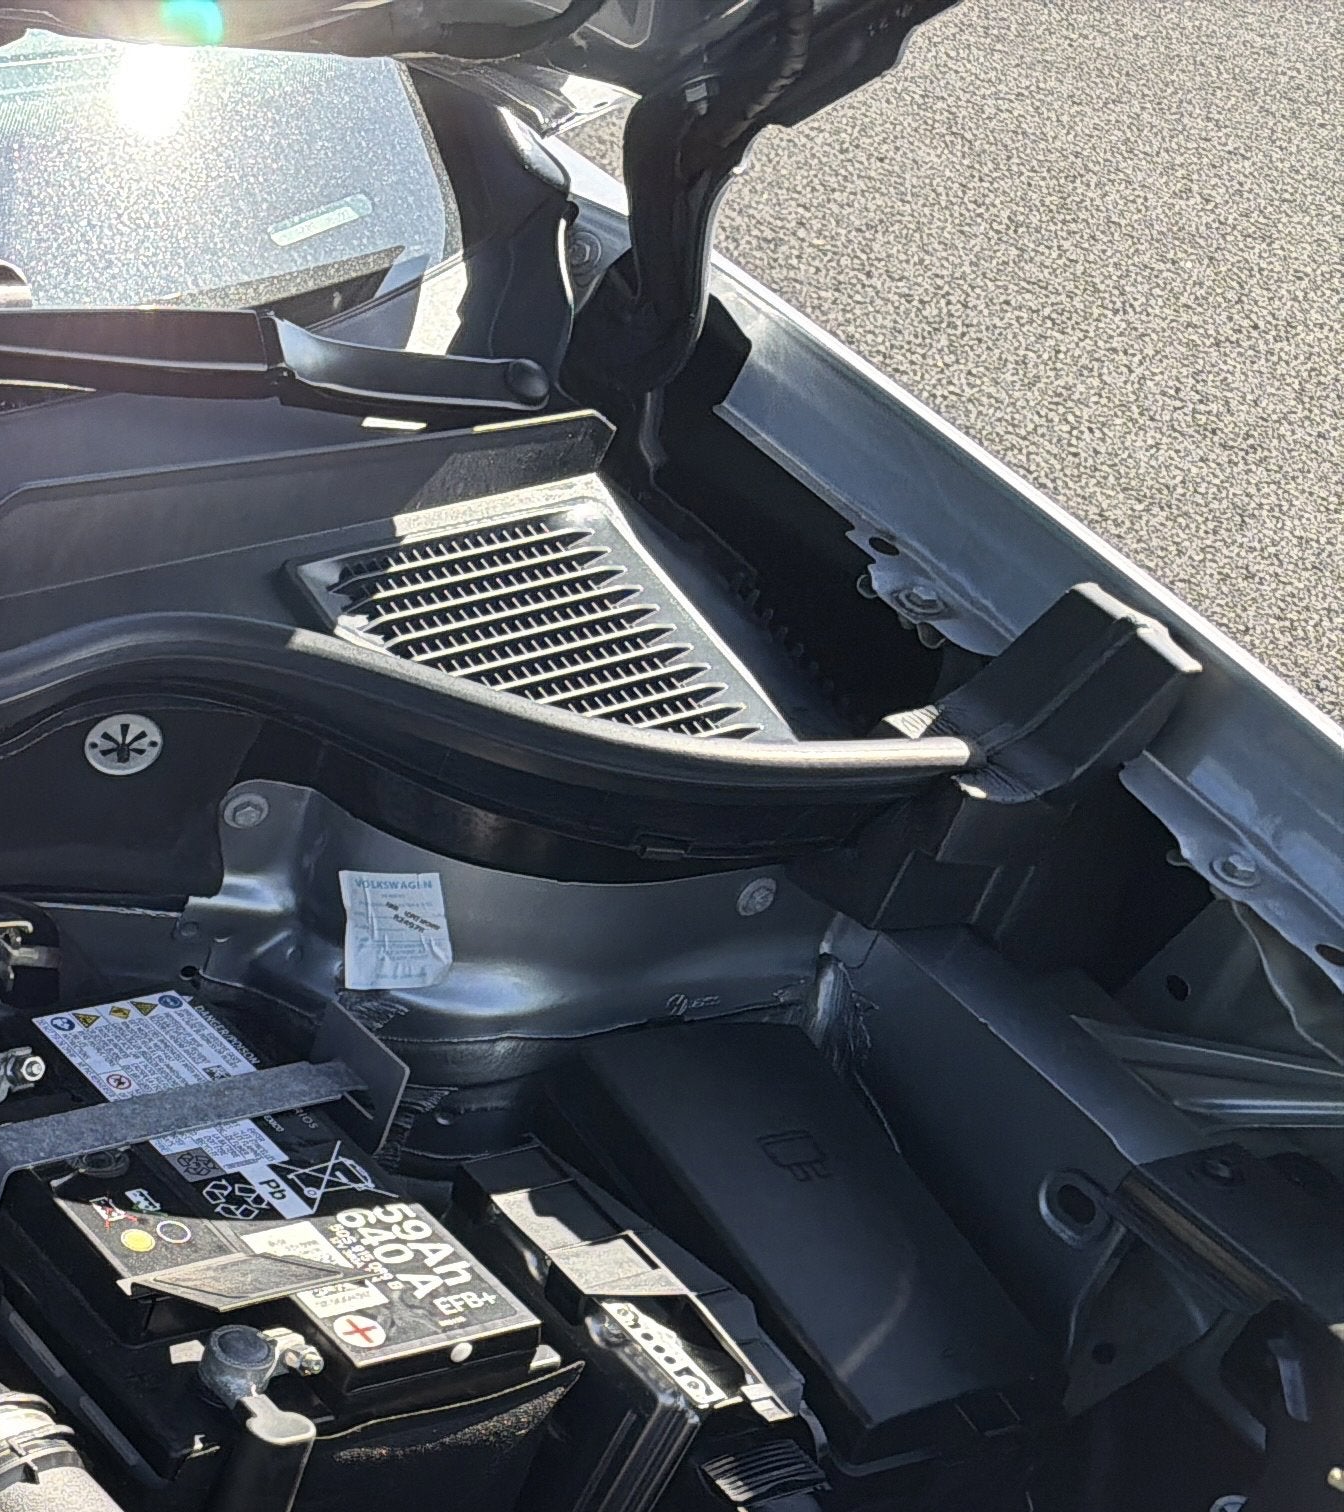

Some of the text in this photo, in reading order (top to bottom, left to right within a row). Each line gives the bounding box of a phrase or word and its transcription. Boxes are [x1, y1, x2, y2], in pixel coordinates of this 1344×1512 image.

[194, 1005, 261, 1065] DANGER/POISON
[258, 1179, 287, 1199] Pb
[336, 1208, 415, 1264] 640
[395, 1273, 443, 1299] A
[373, 1203, 472, 1286] 59Ah
[433, 1291, 498, 1316] EFB+
